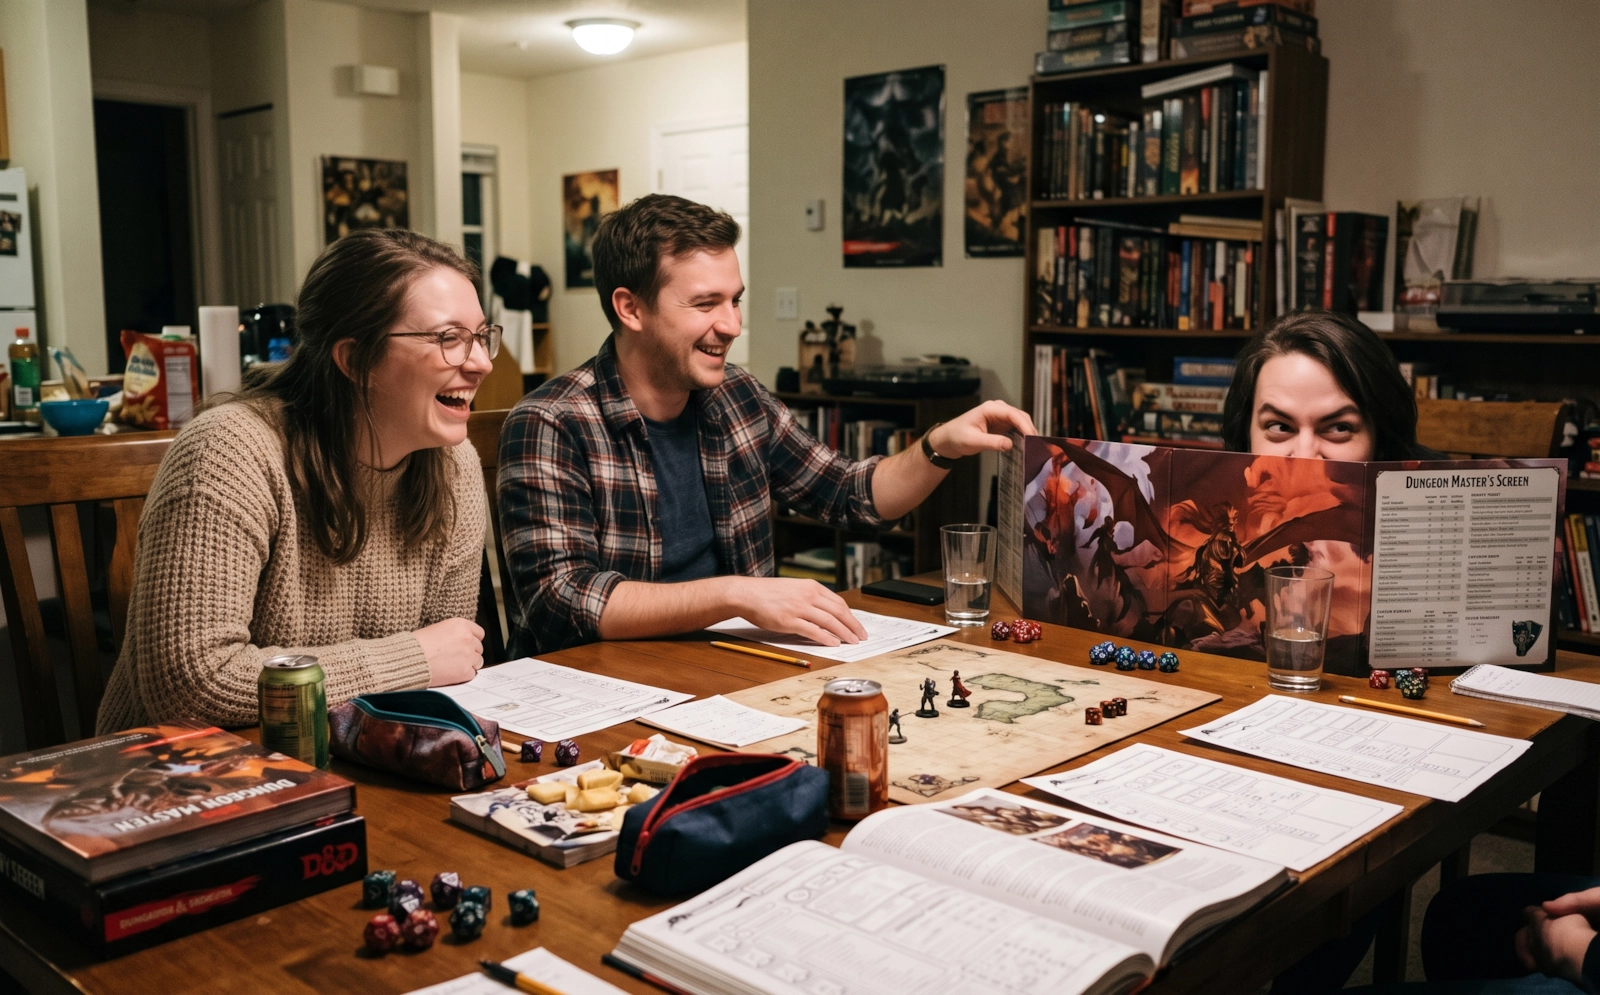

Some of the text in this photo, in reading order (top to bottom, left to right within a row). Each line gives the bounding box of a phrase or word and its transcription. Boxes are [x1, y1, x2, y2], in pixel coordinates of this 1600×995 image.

[1406, 474, 1529, 489] DUNGEON MASTER'S SCREEN
[200, 779, 297, 809] DUNGEON
[300, 842, 359, 880] D&D
